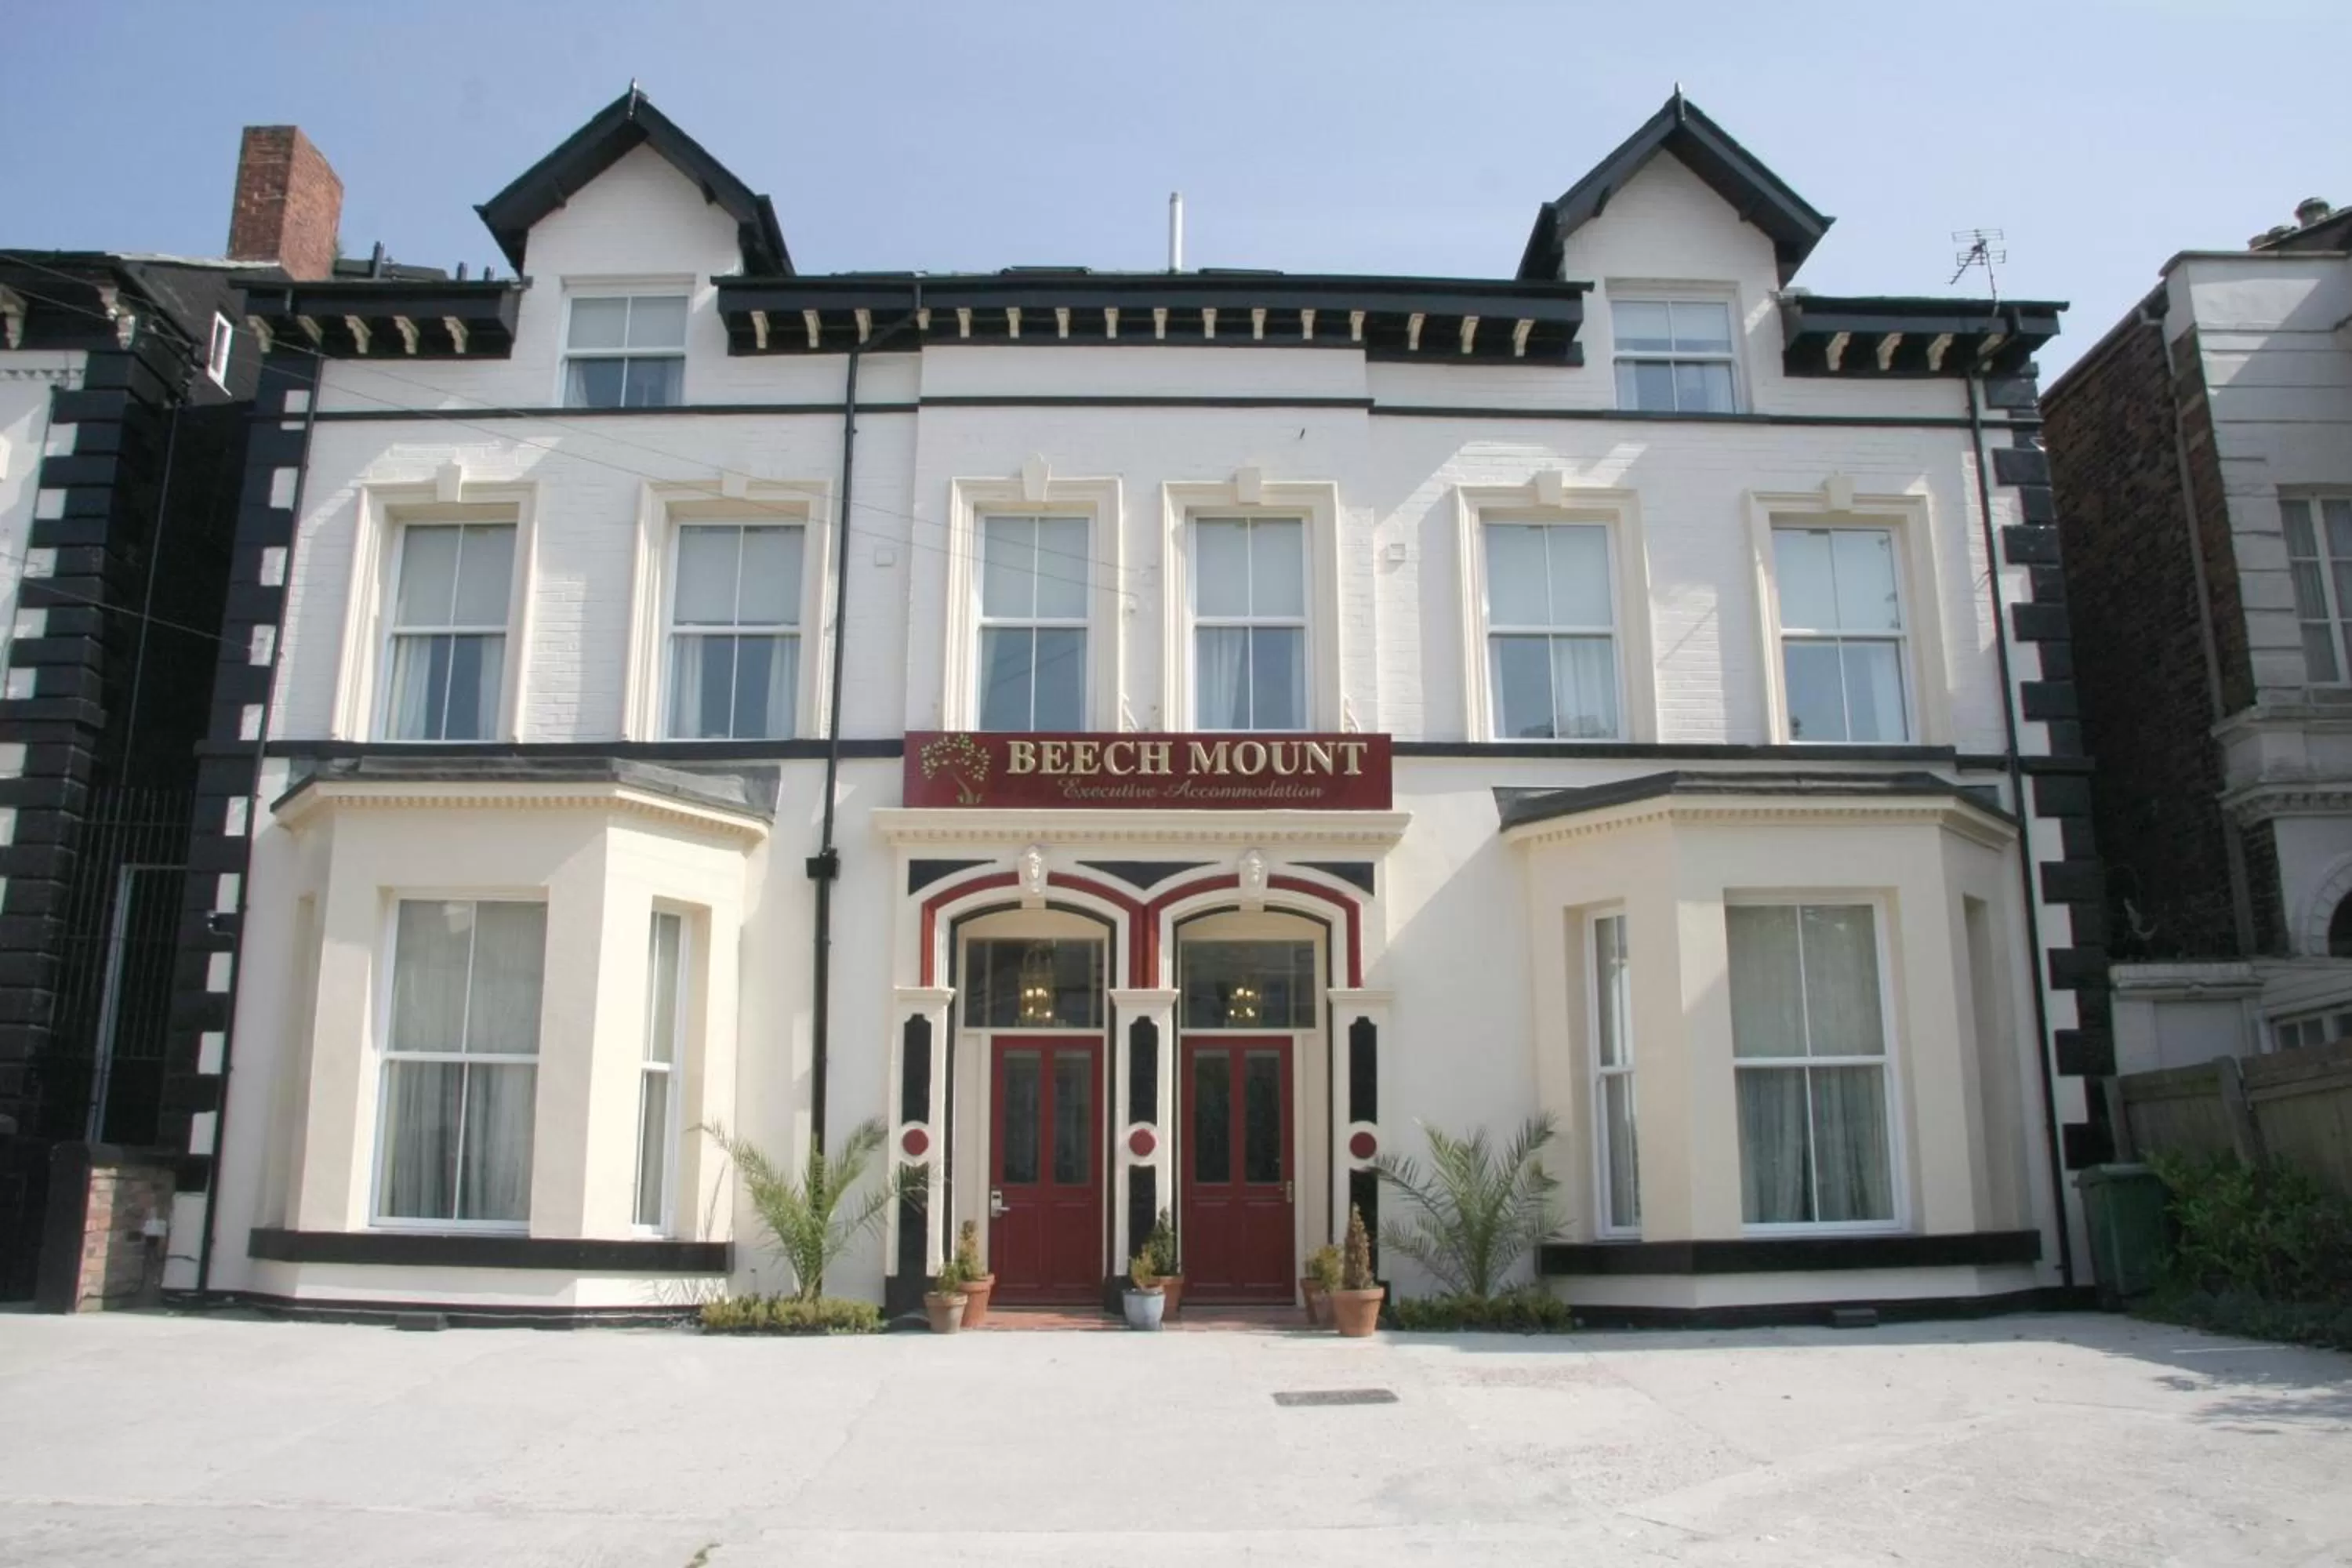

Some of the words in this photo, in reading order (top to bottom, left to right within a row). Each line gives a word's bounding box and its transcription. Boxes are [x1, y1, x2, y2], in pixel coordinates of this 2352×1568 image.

[1007, 741, 1173, 775] BEECH
[1187, 741, 1367, 775] MOUNT
[1058, 779, 1156, 799] Executive
[1163, 779, 1323, 799] Accommodation
